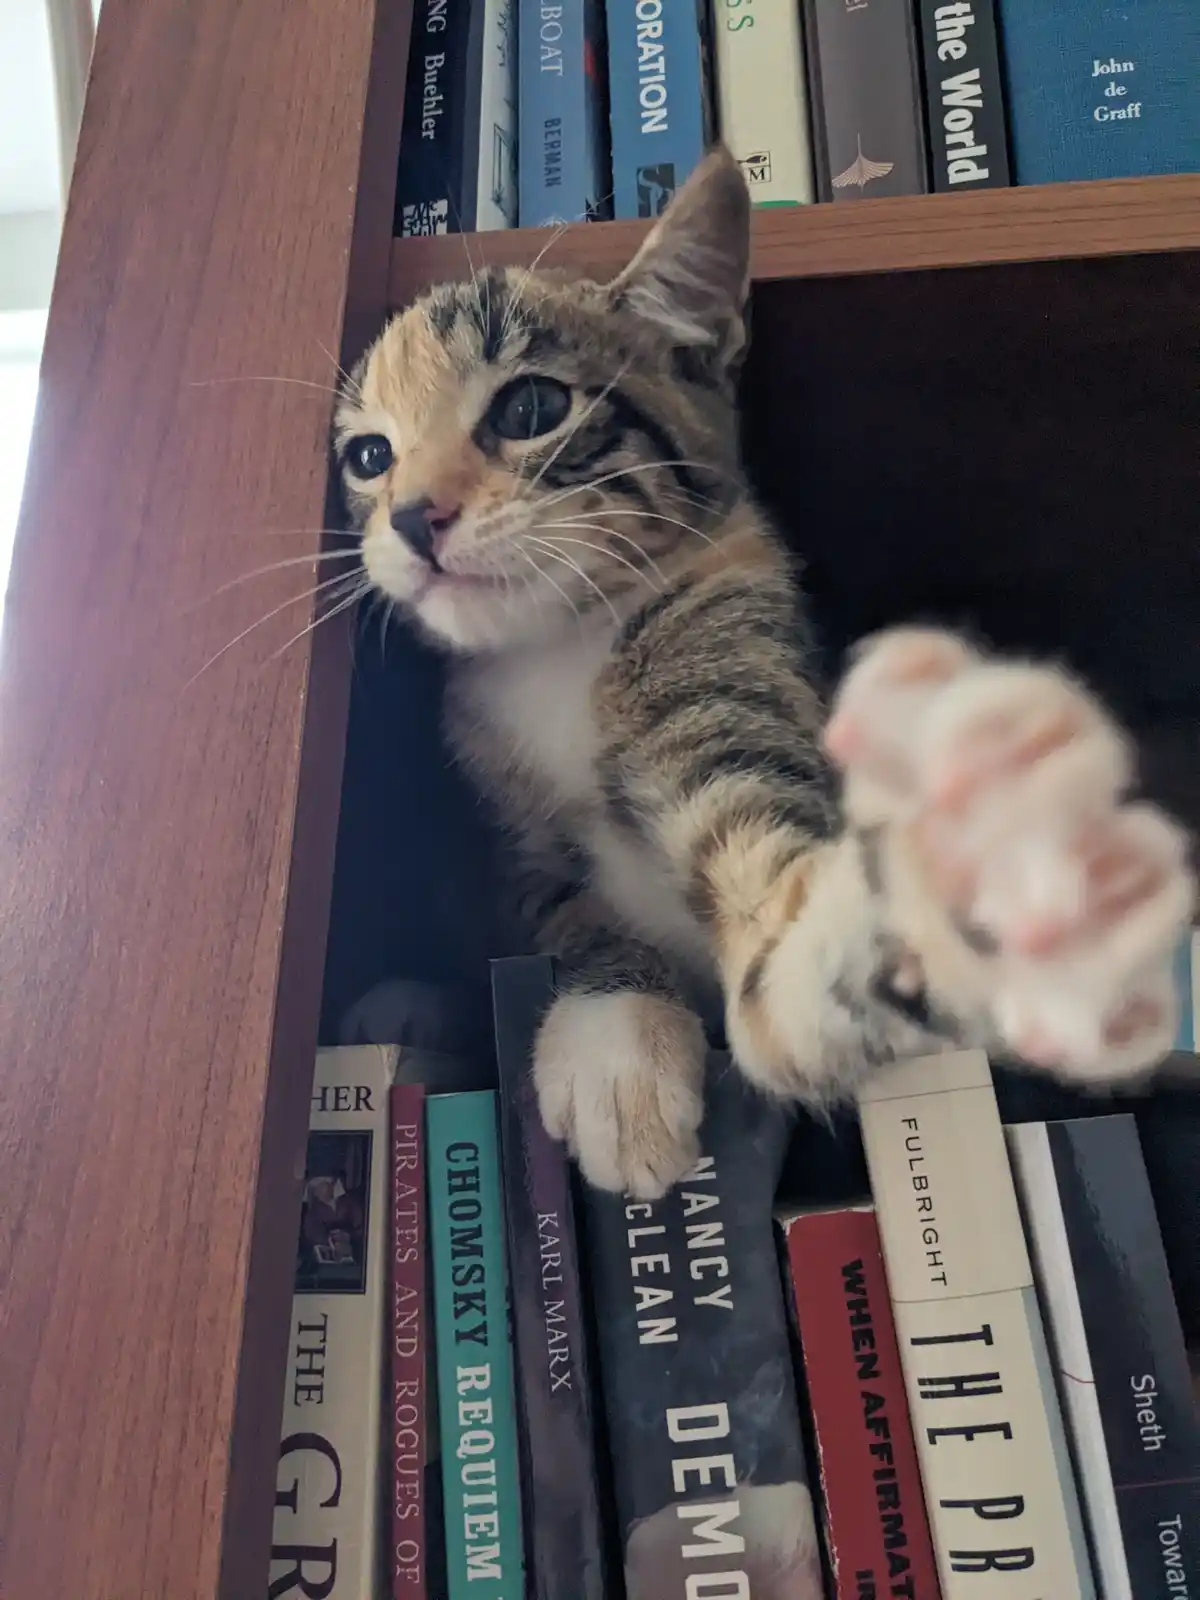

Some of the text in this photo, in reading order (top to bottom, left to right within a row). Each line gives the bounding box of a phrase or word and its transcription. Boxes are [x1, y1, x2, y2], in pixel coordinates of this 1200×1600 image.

[421, 52, 445, 139] Buehler
[540, 0, 563, 76] BOAT
[635, 0, 668, 133] ORATION
[934, 1, 989, 185] the World
[1092, 58, 1134, 77] John
[1104, 81, 1128, 97] de
[543, 117, 562, 187] BERMAN
[1094, 102, 1142, 122] Graff
[901, 1117, 947, 1286] FULBRIGHT
[537, 1212, 572, 1392] KARL MARX
[624, 1192, 679, 1345] CLEAN
[294, 1313, 329, 1407] THE
[395, 1124, 420, 1583] PIRATES AND ROGUES OF
[445, 1141, 503, 1582] CHOMSKY REQUIEM
[910, 1323, 1013, 1446] THE
[1130, 1374, 1167, 1452] Sheth
[841, 1258, 915, 1600] WHEN AFFIRMAT
[666, 1402, 750, 1600] DEMO
